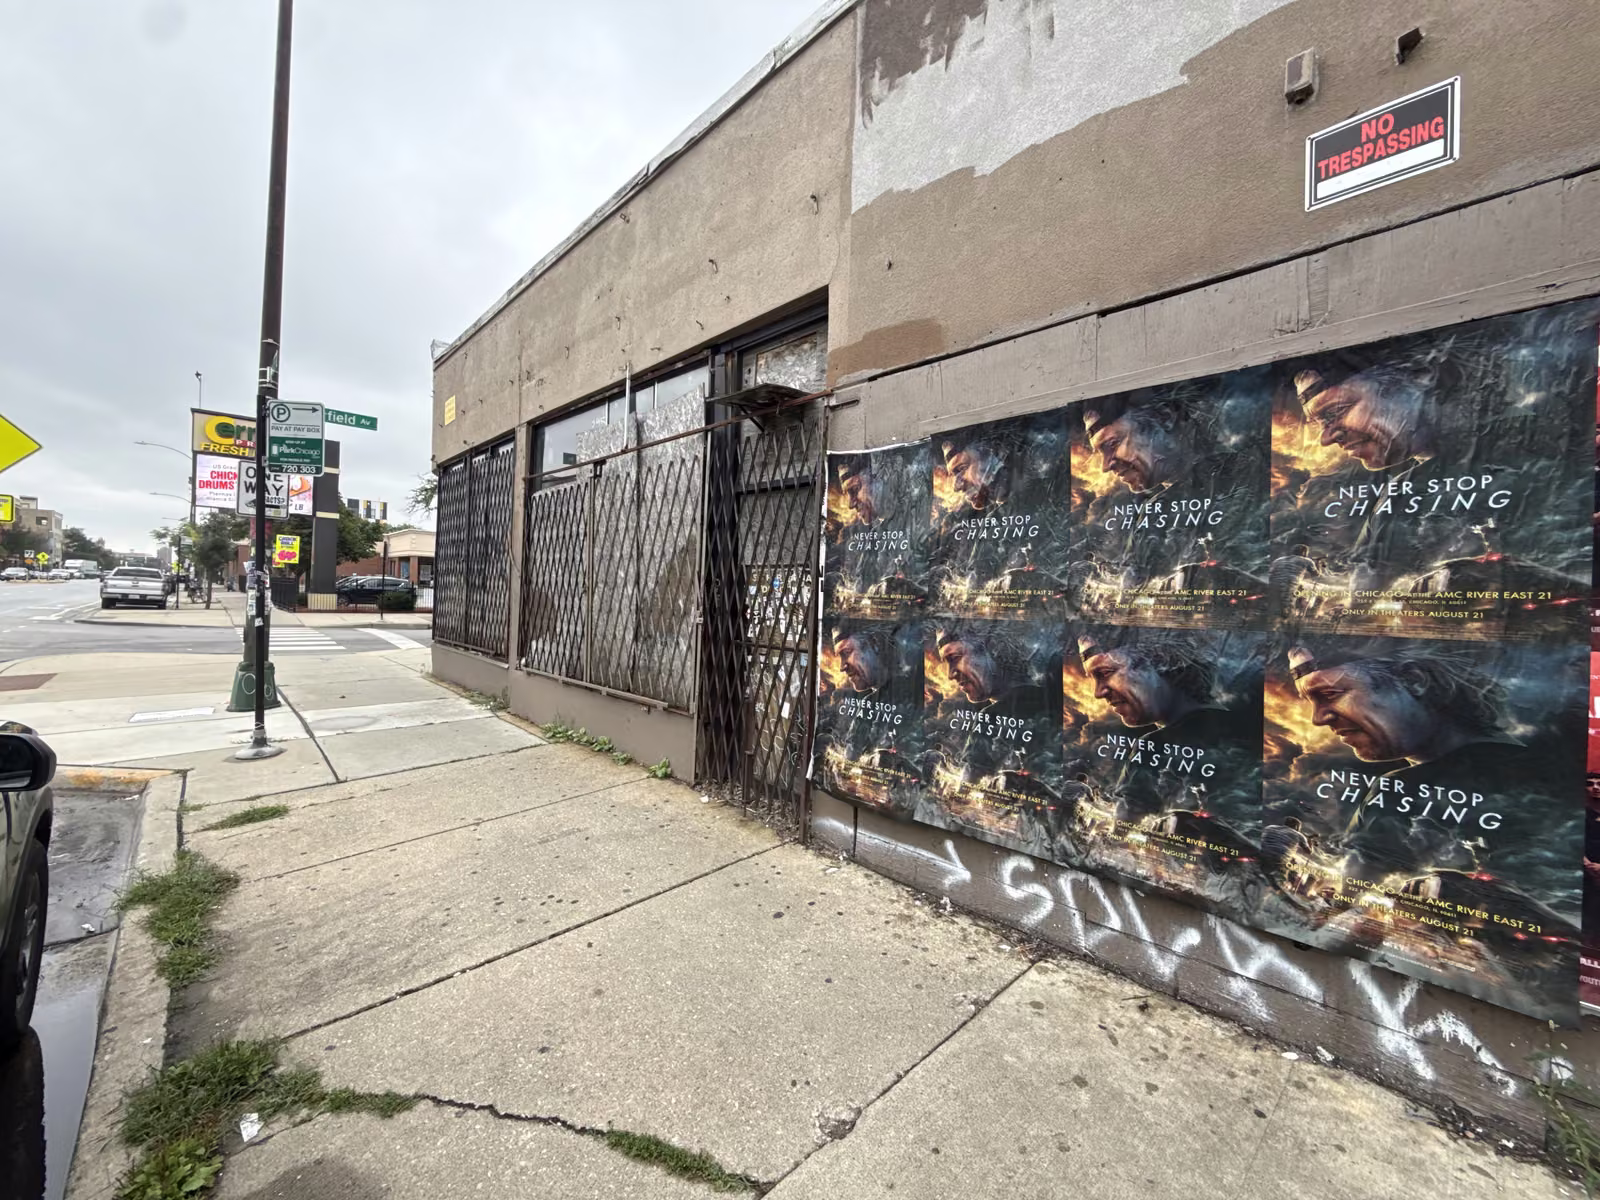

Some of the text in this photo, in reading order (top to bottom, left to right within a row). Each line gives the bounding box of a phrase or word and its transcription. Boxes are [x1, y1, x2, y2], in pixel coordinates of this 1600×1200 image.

[1361, 113, 1394, 142] NO
[1318, 116, 1444, 179] TRESPASSING
[328, 410, 371, 426] field Av
[200, 442, 249, 456] FRESH
[236, 440, 254, 448] PR
[300, 466, 316, 474] 303
[1339, 474, 1493, 500] NEVER STOP
[1114, 498, 1212, 516] NEVER STOP
[1324, 490, 1512, 518] CHASING
[962, 514, 1031, 528] NEVER STOP
[1105, 510, 1224, 531] CHASING
[854, 531, 904, 541] NEVER STOP
[954, 525, 1040, 541] CHASING
[848, 540, 908, 551] CHASING
[1354, 590, 1403, 598] CHICAGO
[838, 705, 903, 725] CHASING
[844, 698, 896, 712] NEVER STOP
[956, 708, 1024, 729] NEVER STOP
[950, 718, 1033, 743] CHASING
[1107, 734, 1204, 760] NEVER STOP
[1097, 744, 1216, 778] CHASING
[1331, 769, 1484, 807] NEVER STOP
[1316, 782, 1503, 830] CHASING
[1116, 820, 1148, 832] CHICAGO
[1166, 832, 1184, 842] AMC
[1186, 838, 1207, 848] RIVER
[1210, 844, 1228, 854] EAST
[1161, 848, 1188, 860] AUGUST
[1332, 894, 1356, 904] ONLY
[1358, 899, 1368, 908] IN
[1372, 903, 1416, 920] THEATERS
[1420, 916, 1460, 932] AUGUST
[1463, 928, 1474, 937] 21
[1346, 877, 1396, 894] CHICAGO
[1426, 898, 1453, 910] AMC
[1456, 904, 1489, 920] RIVER
[1494, 914, 1524, 928] EAST
[1528, 924, 1542, 934] 21
